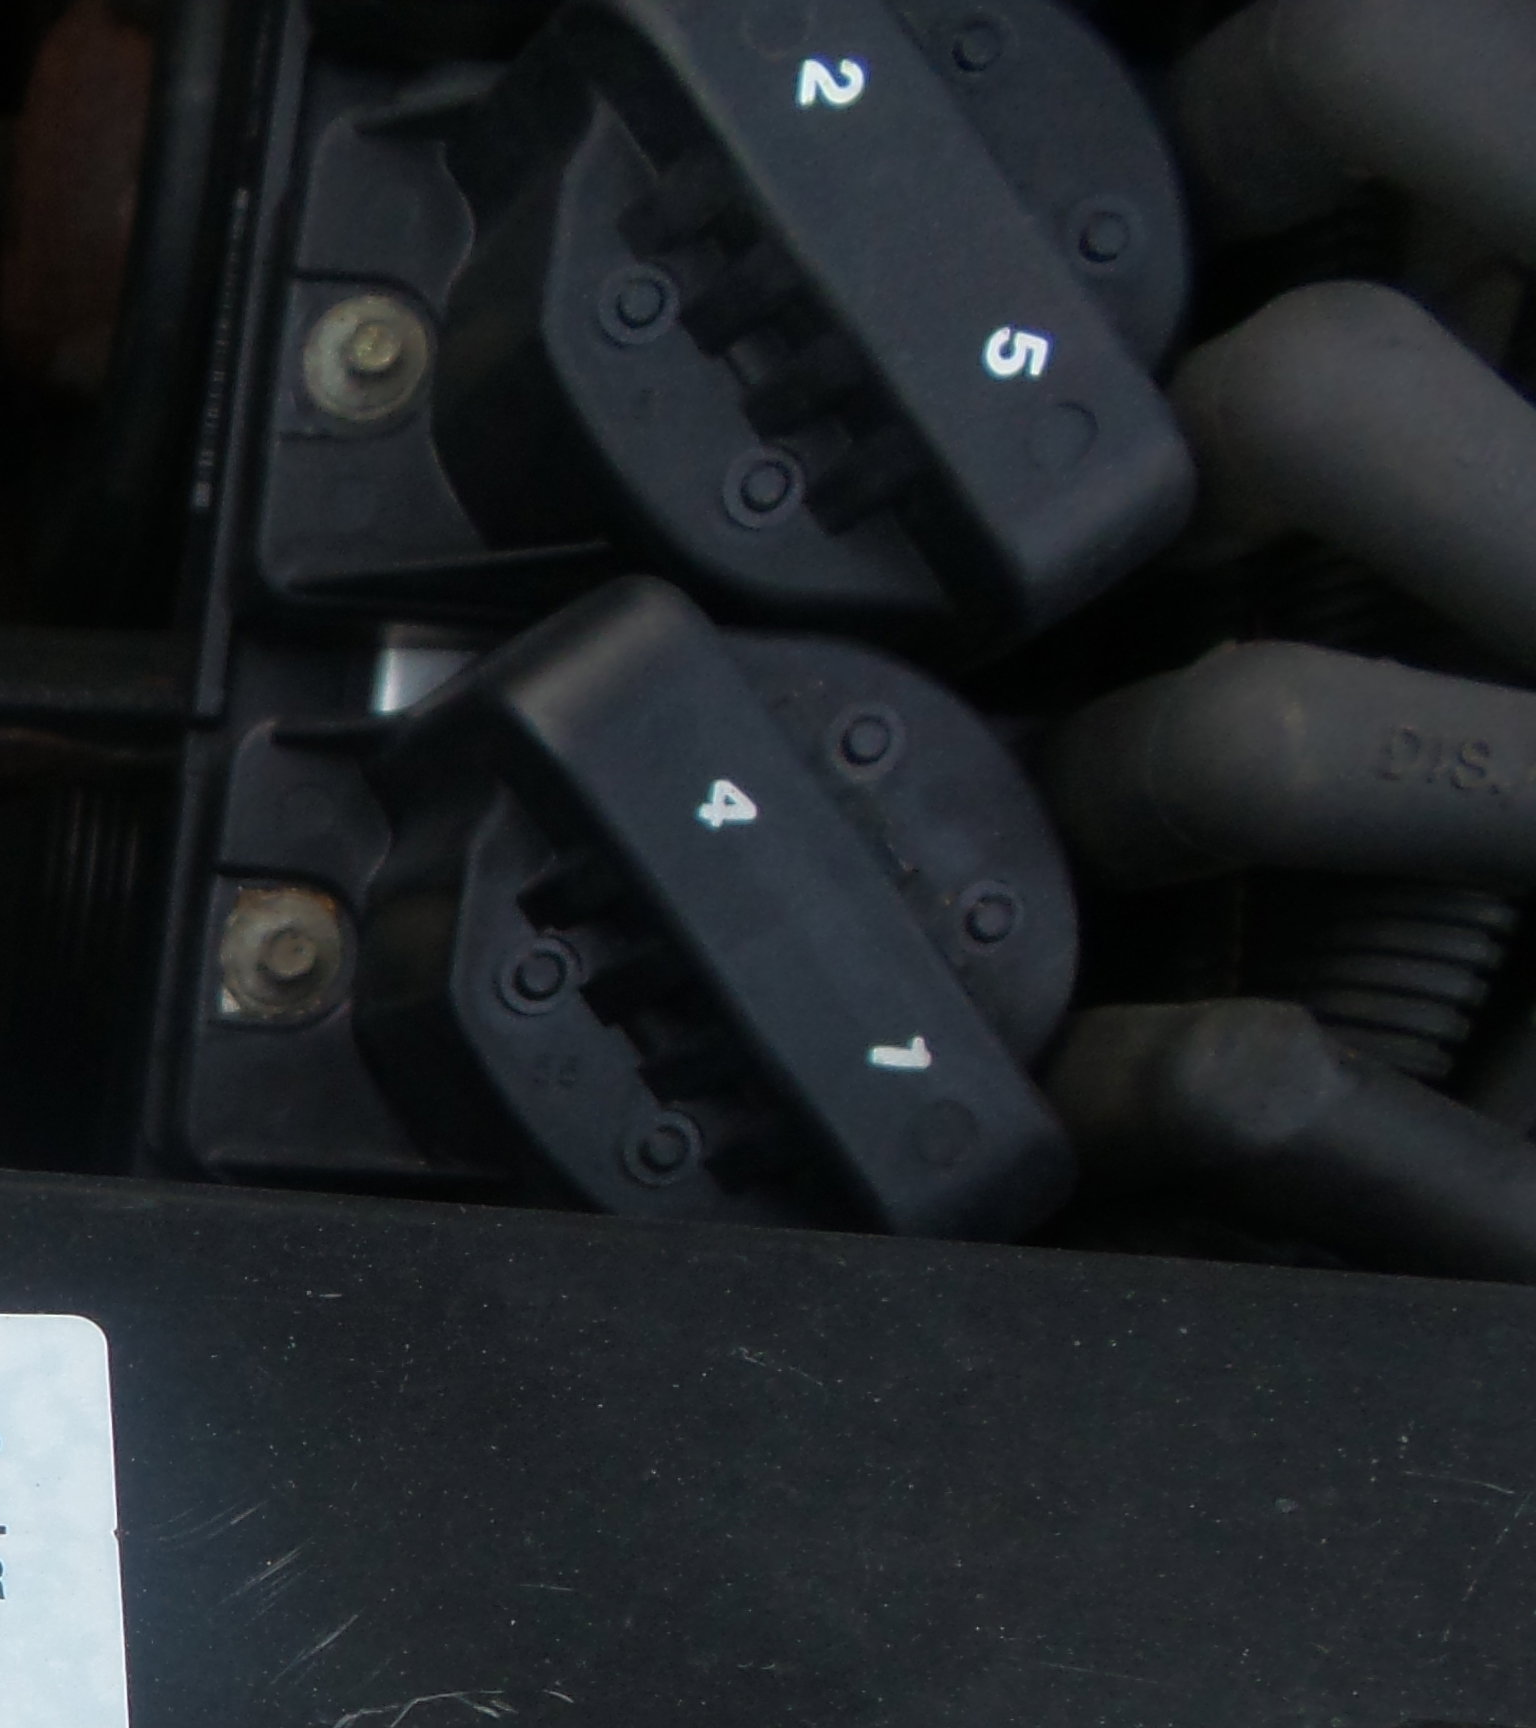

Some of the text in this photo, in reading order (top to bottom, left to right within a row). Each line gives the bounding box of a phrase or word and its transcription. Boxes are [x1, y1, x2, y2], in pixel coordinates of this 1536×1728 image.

[798, 58, 866, 107] 2
[983, 325, 1050, 380] 5
[697, 777, 759, 829] 4
[866, 1035, 933, 1073] 1
